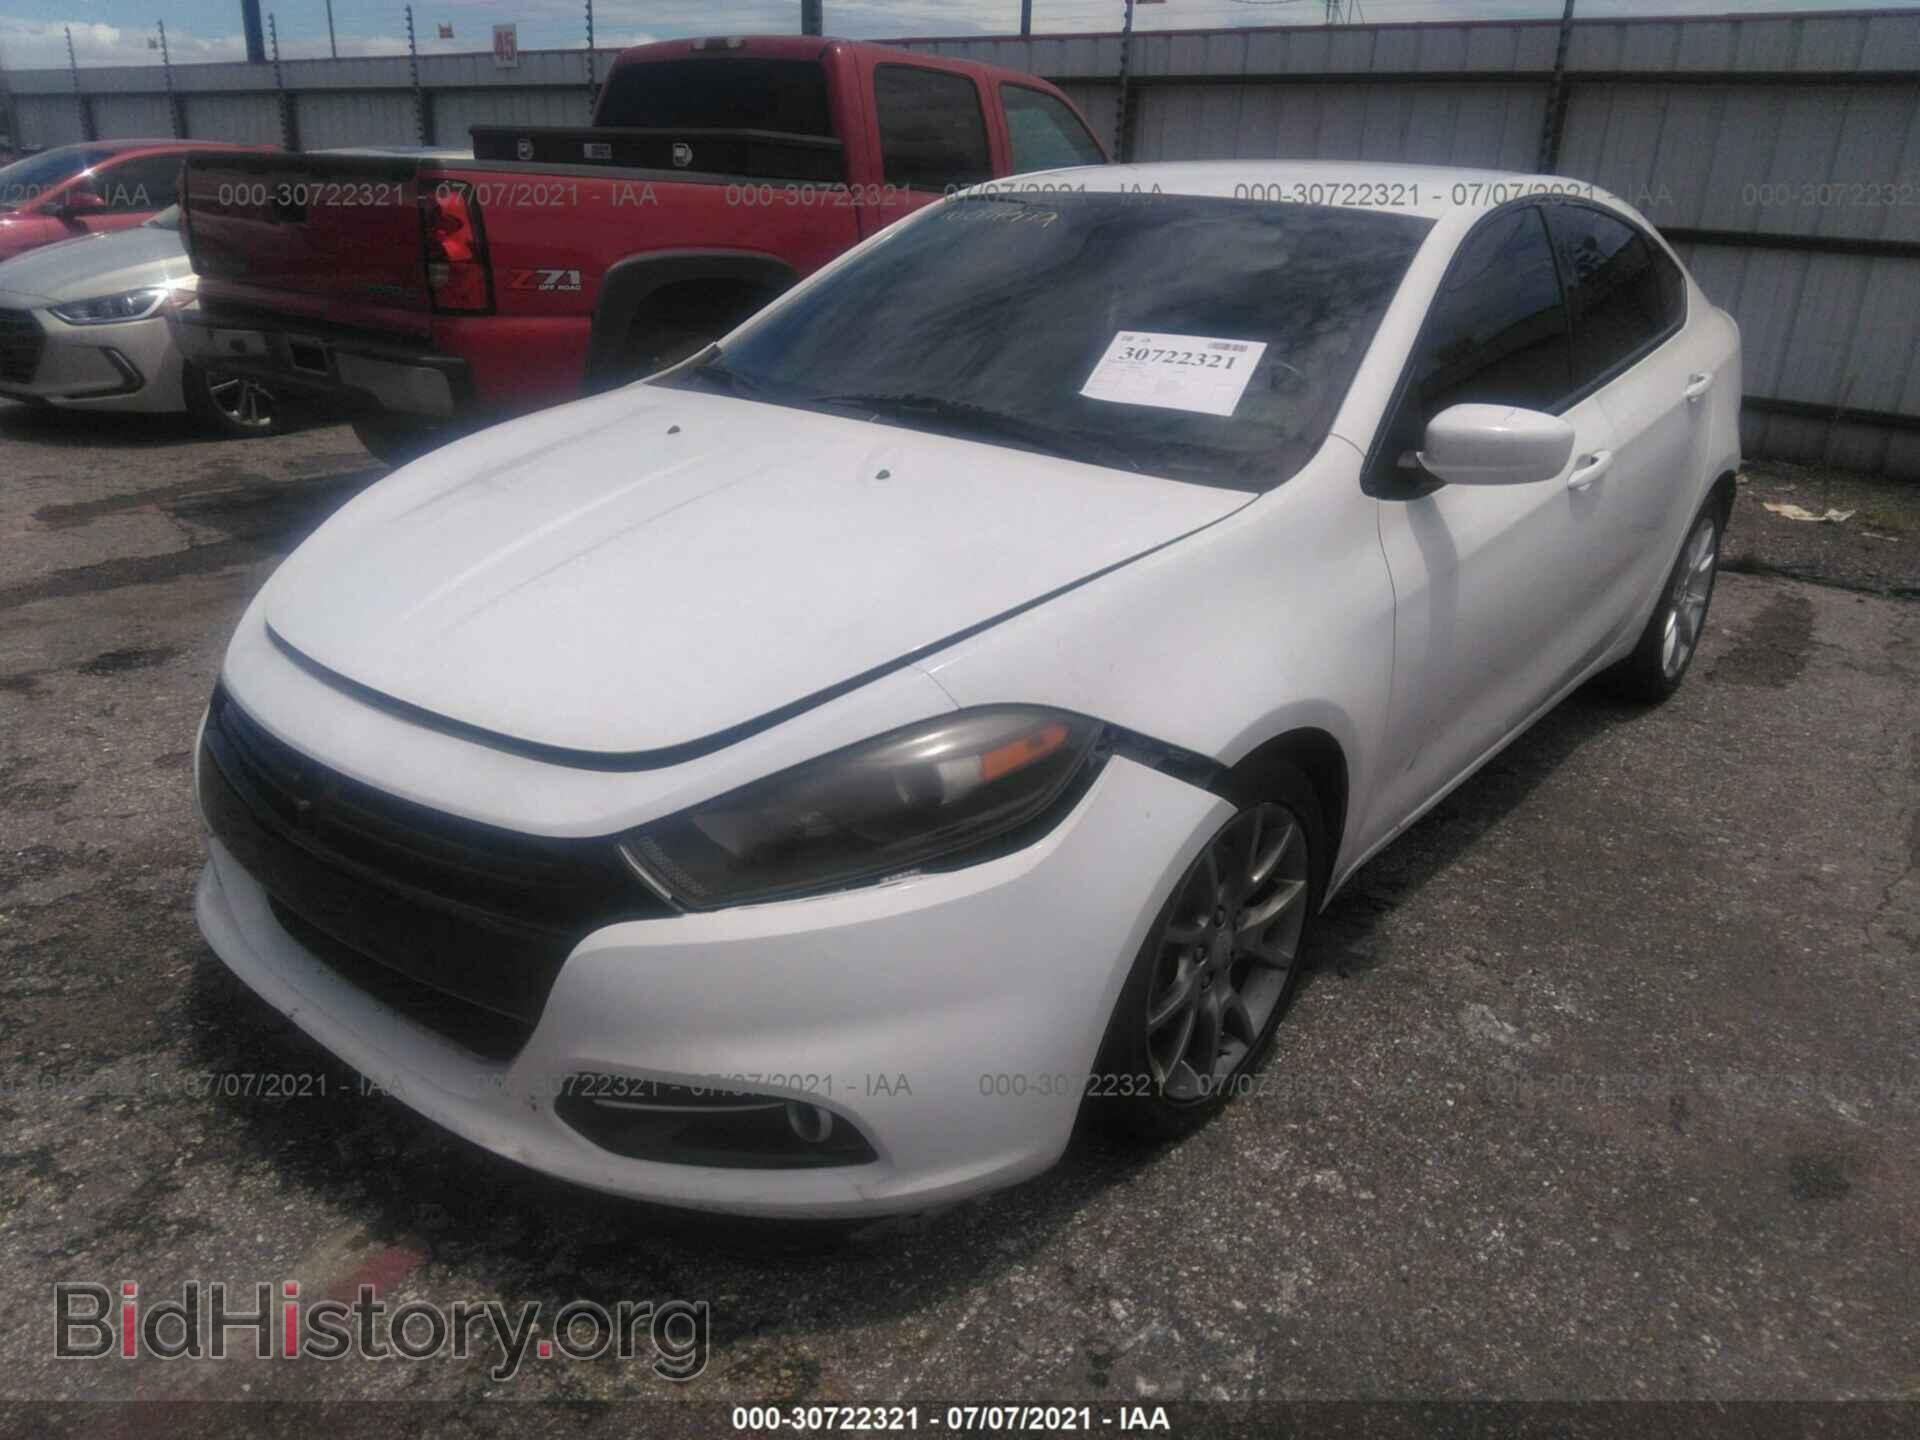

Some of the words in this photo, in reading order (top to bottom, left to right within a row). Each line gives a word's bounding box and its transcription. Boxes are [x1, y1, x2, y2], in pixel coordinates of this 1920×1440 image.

[495, 31, 514, 57] 45
[505, 270, 581, 290] Z71
[1118, 346, 1236, 370] 30722321
